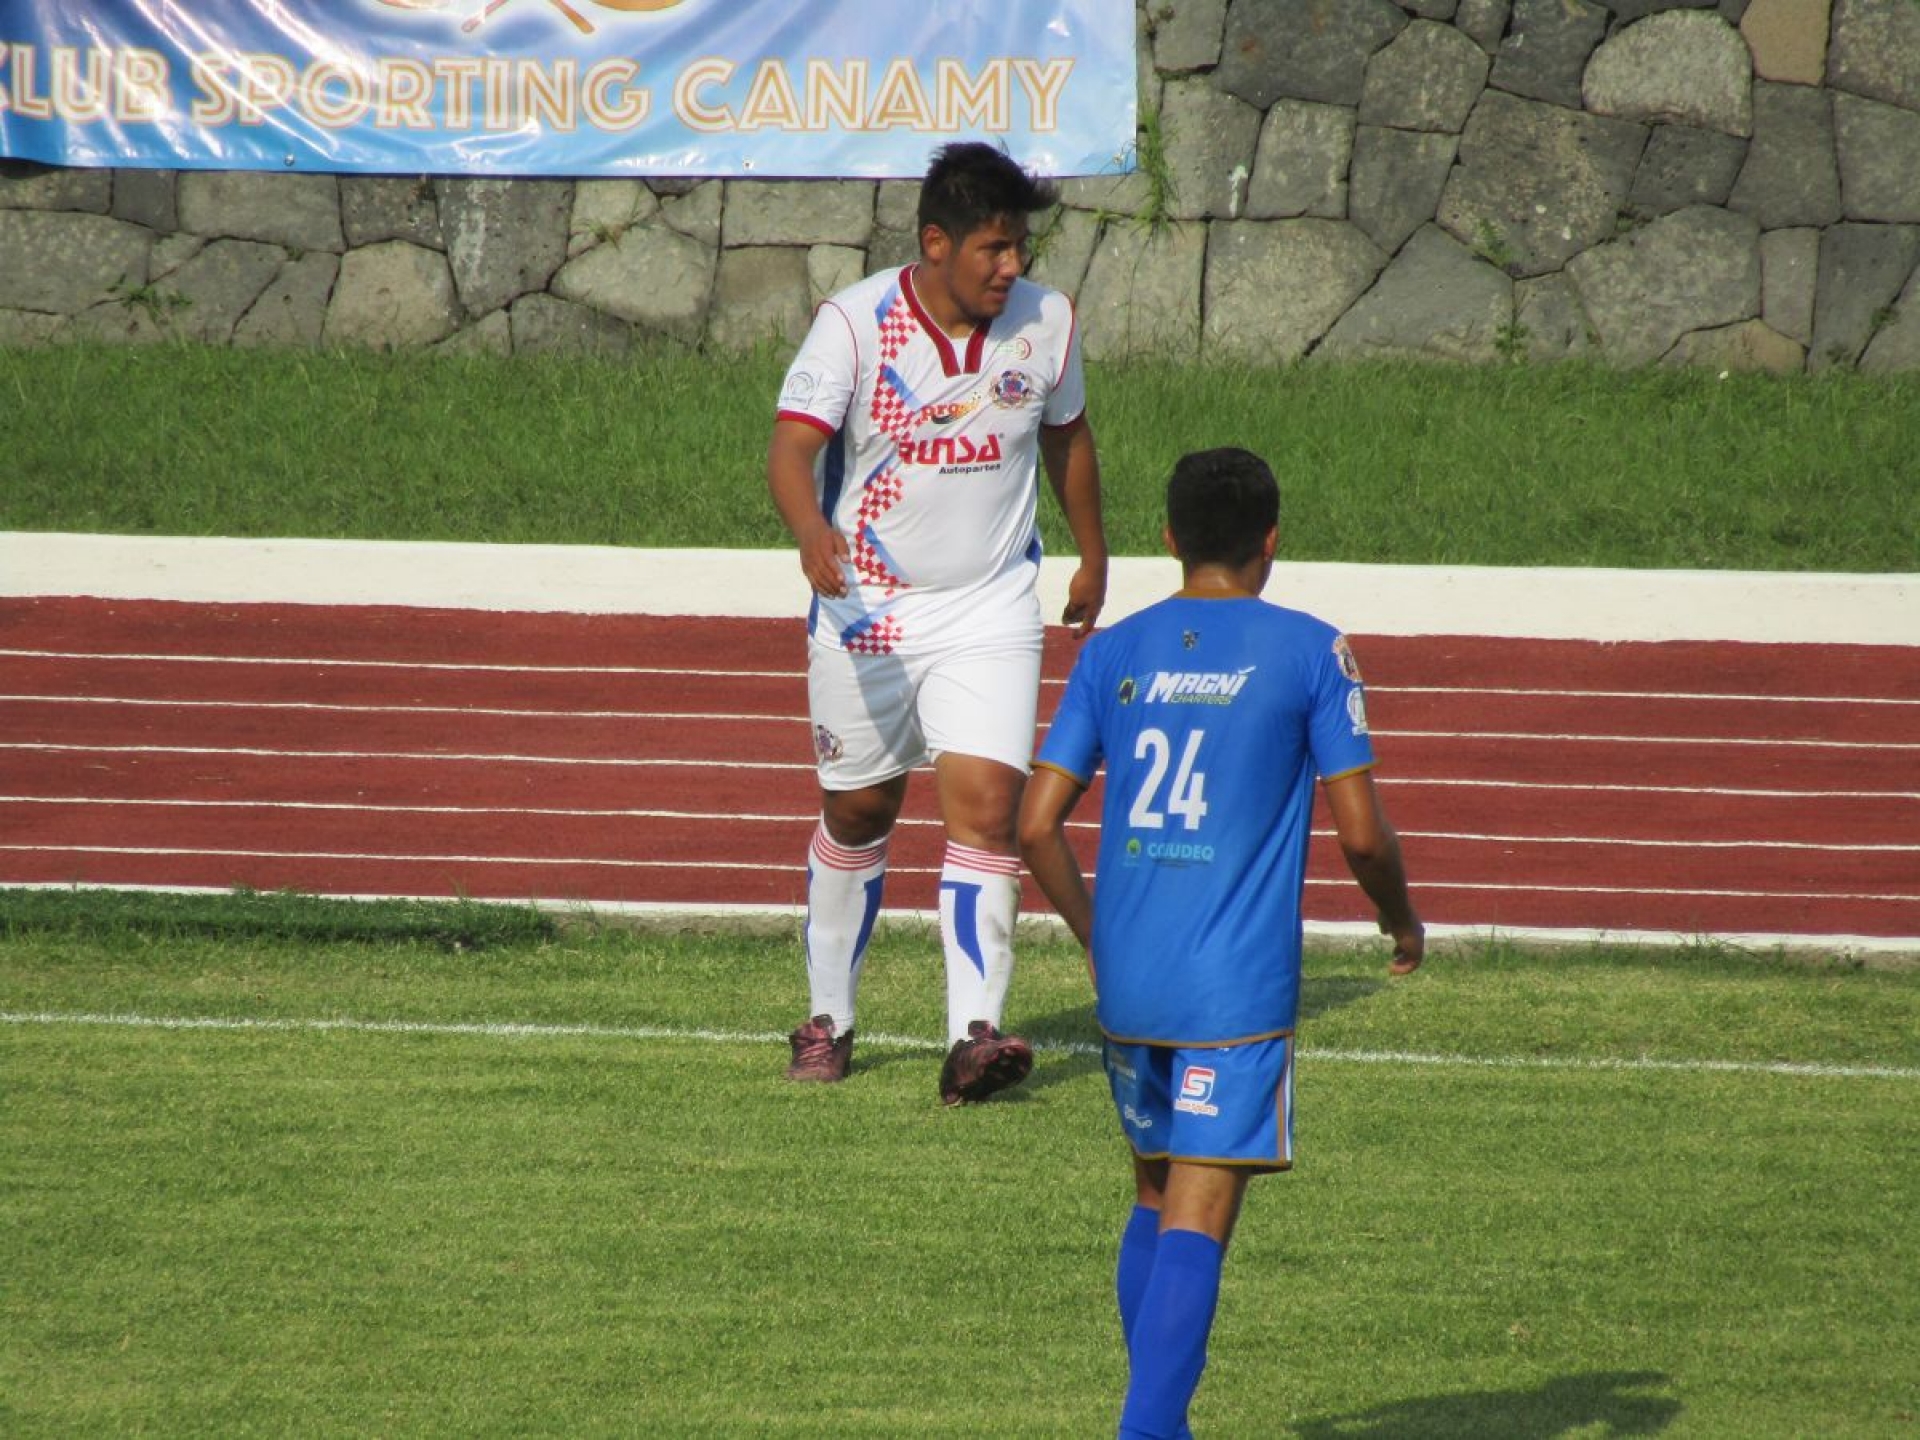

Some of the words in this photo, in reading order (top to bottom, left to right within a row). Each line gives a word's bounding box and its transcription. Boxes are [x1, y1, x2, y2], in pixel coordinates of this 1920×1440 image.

[0, 42, 171, 124] LUB
[191, 52, 649, 133] SPORTING
[672, 57, 1075, 133] CANAMY
[1129, 728, 1208, 830] 24
